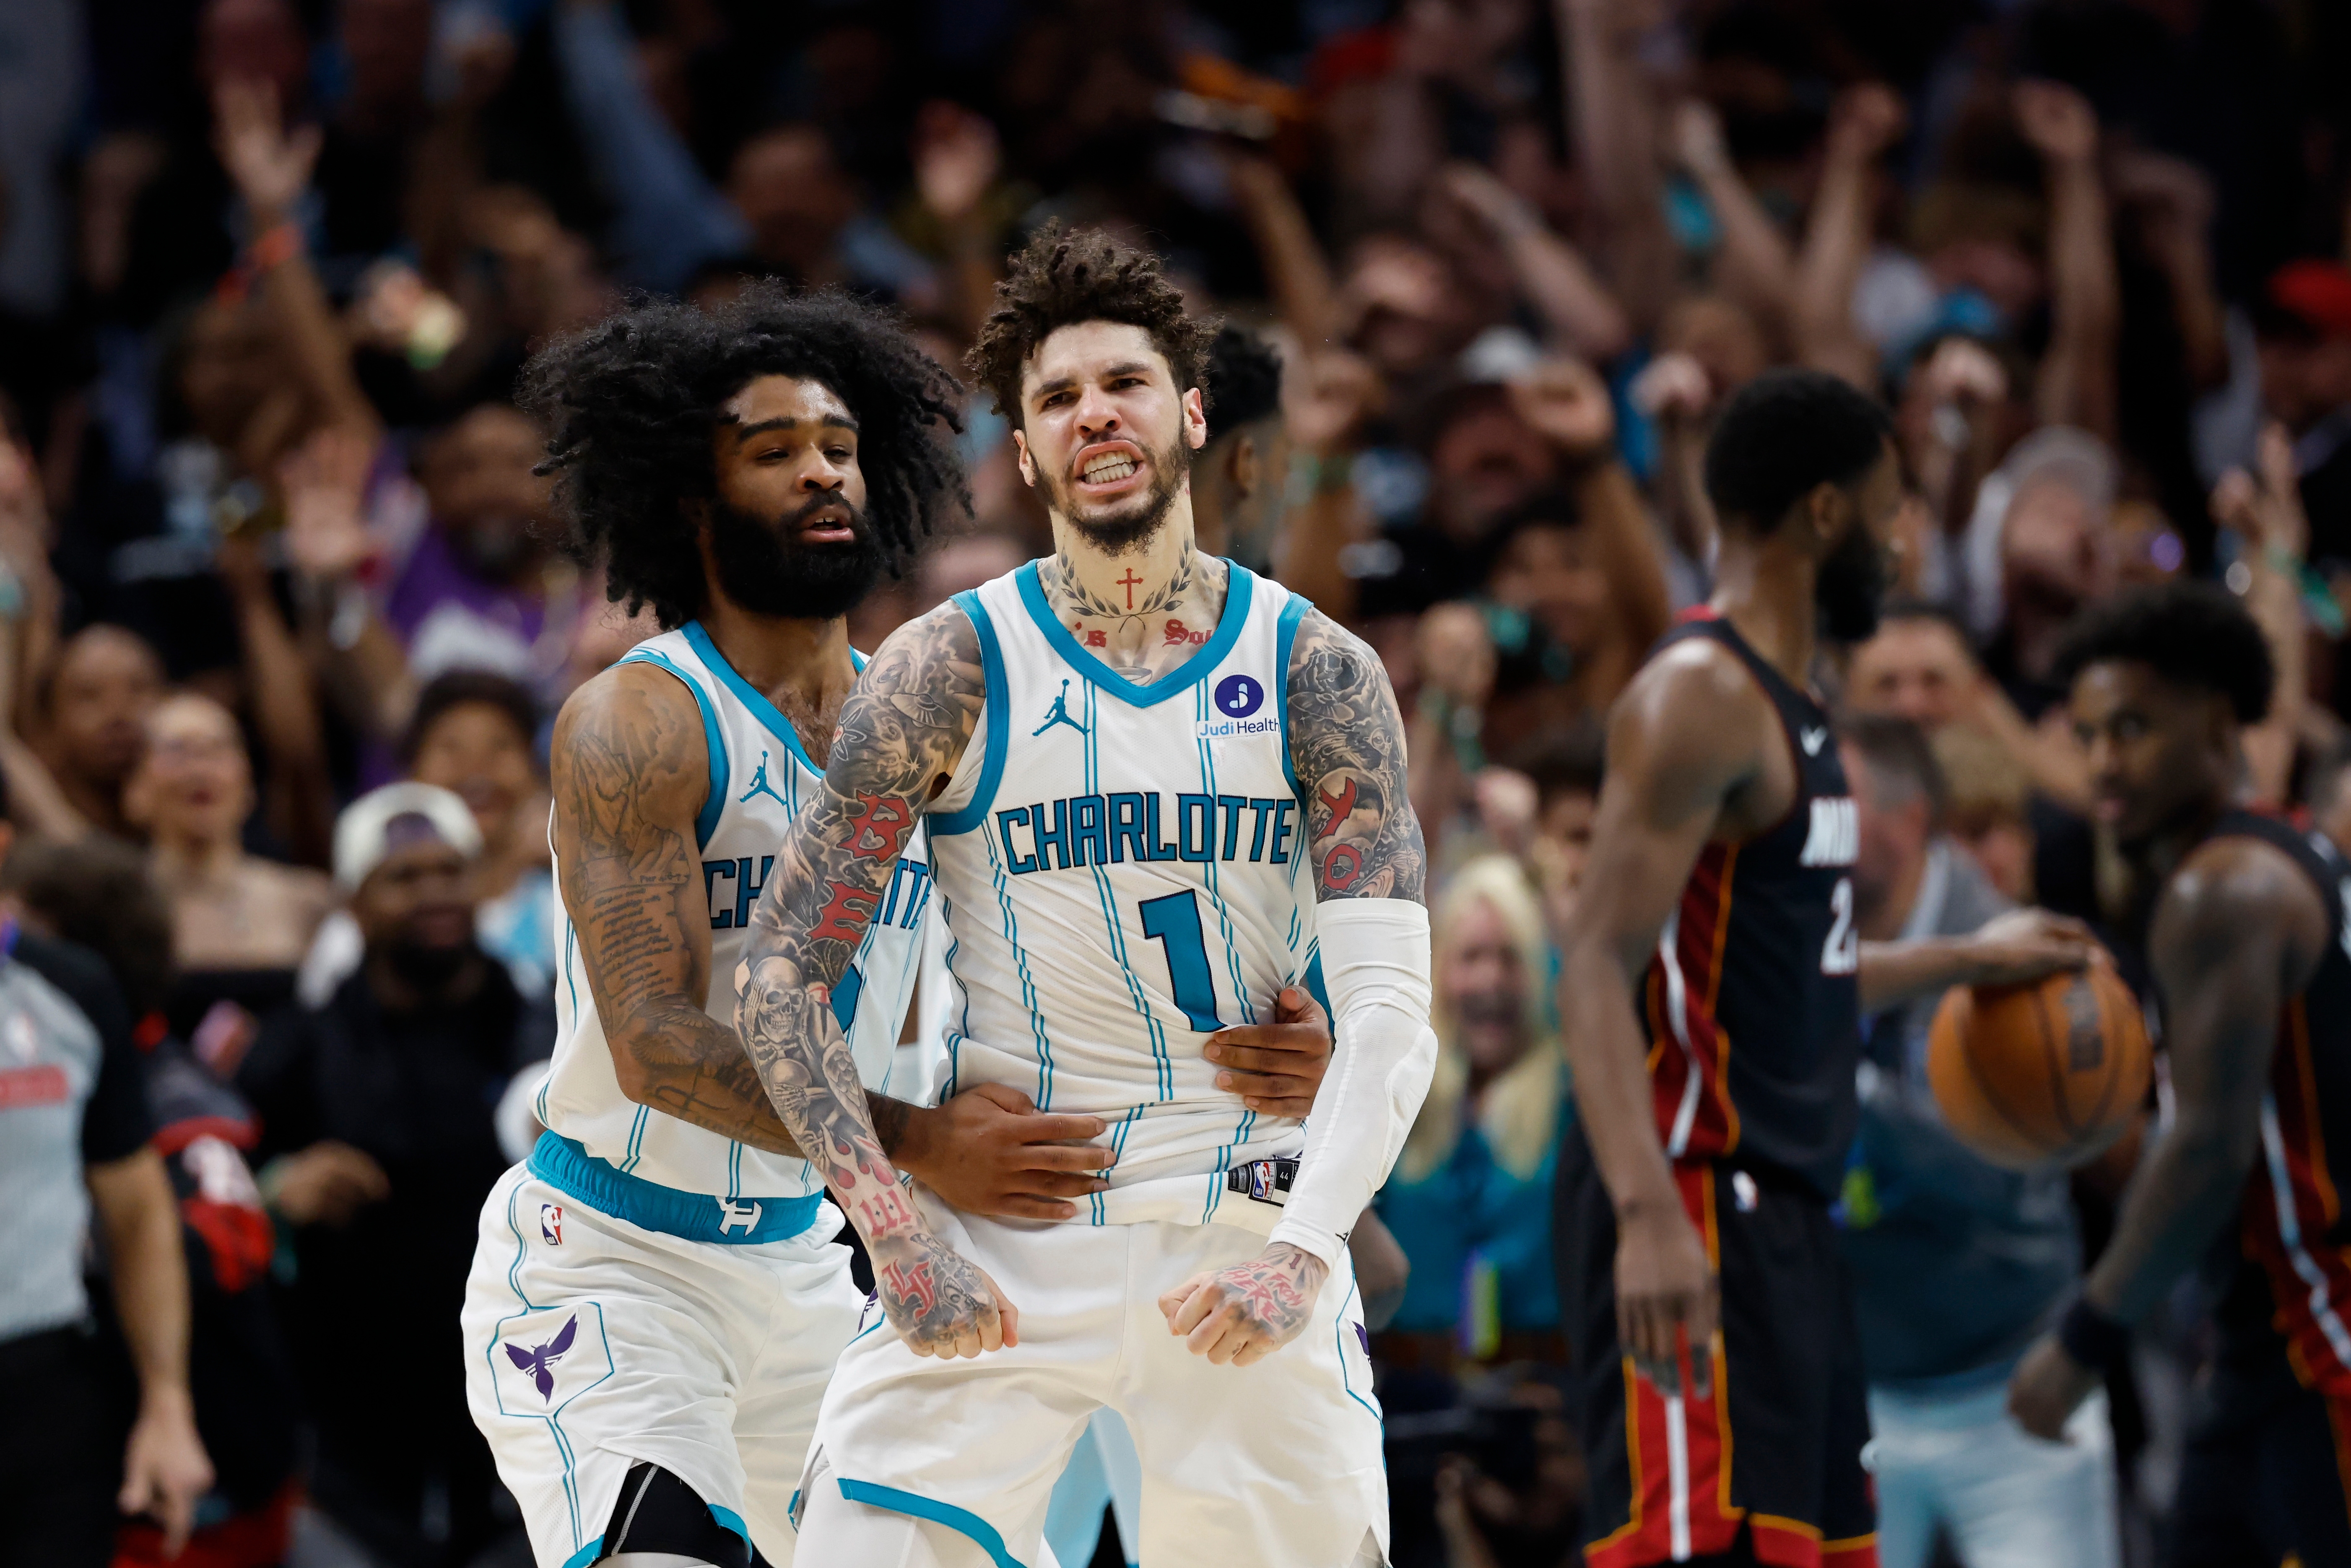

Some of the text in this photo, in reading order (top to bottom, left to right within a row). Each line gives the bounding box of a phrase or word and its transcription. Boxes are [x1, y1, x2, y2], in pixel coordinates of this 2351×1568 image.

[1200, 718, 1280, 736] Judi Health
[995, 792, 1296, 875] CHARLOTTE
[1138, 888, 1228, 1033] 1
[1280, 1171, 1289, 1181] 44
